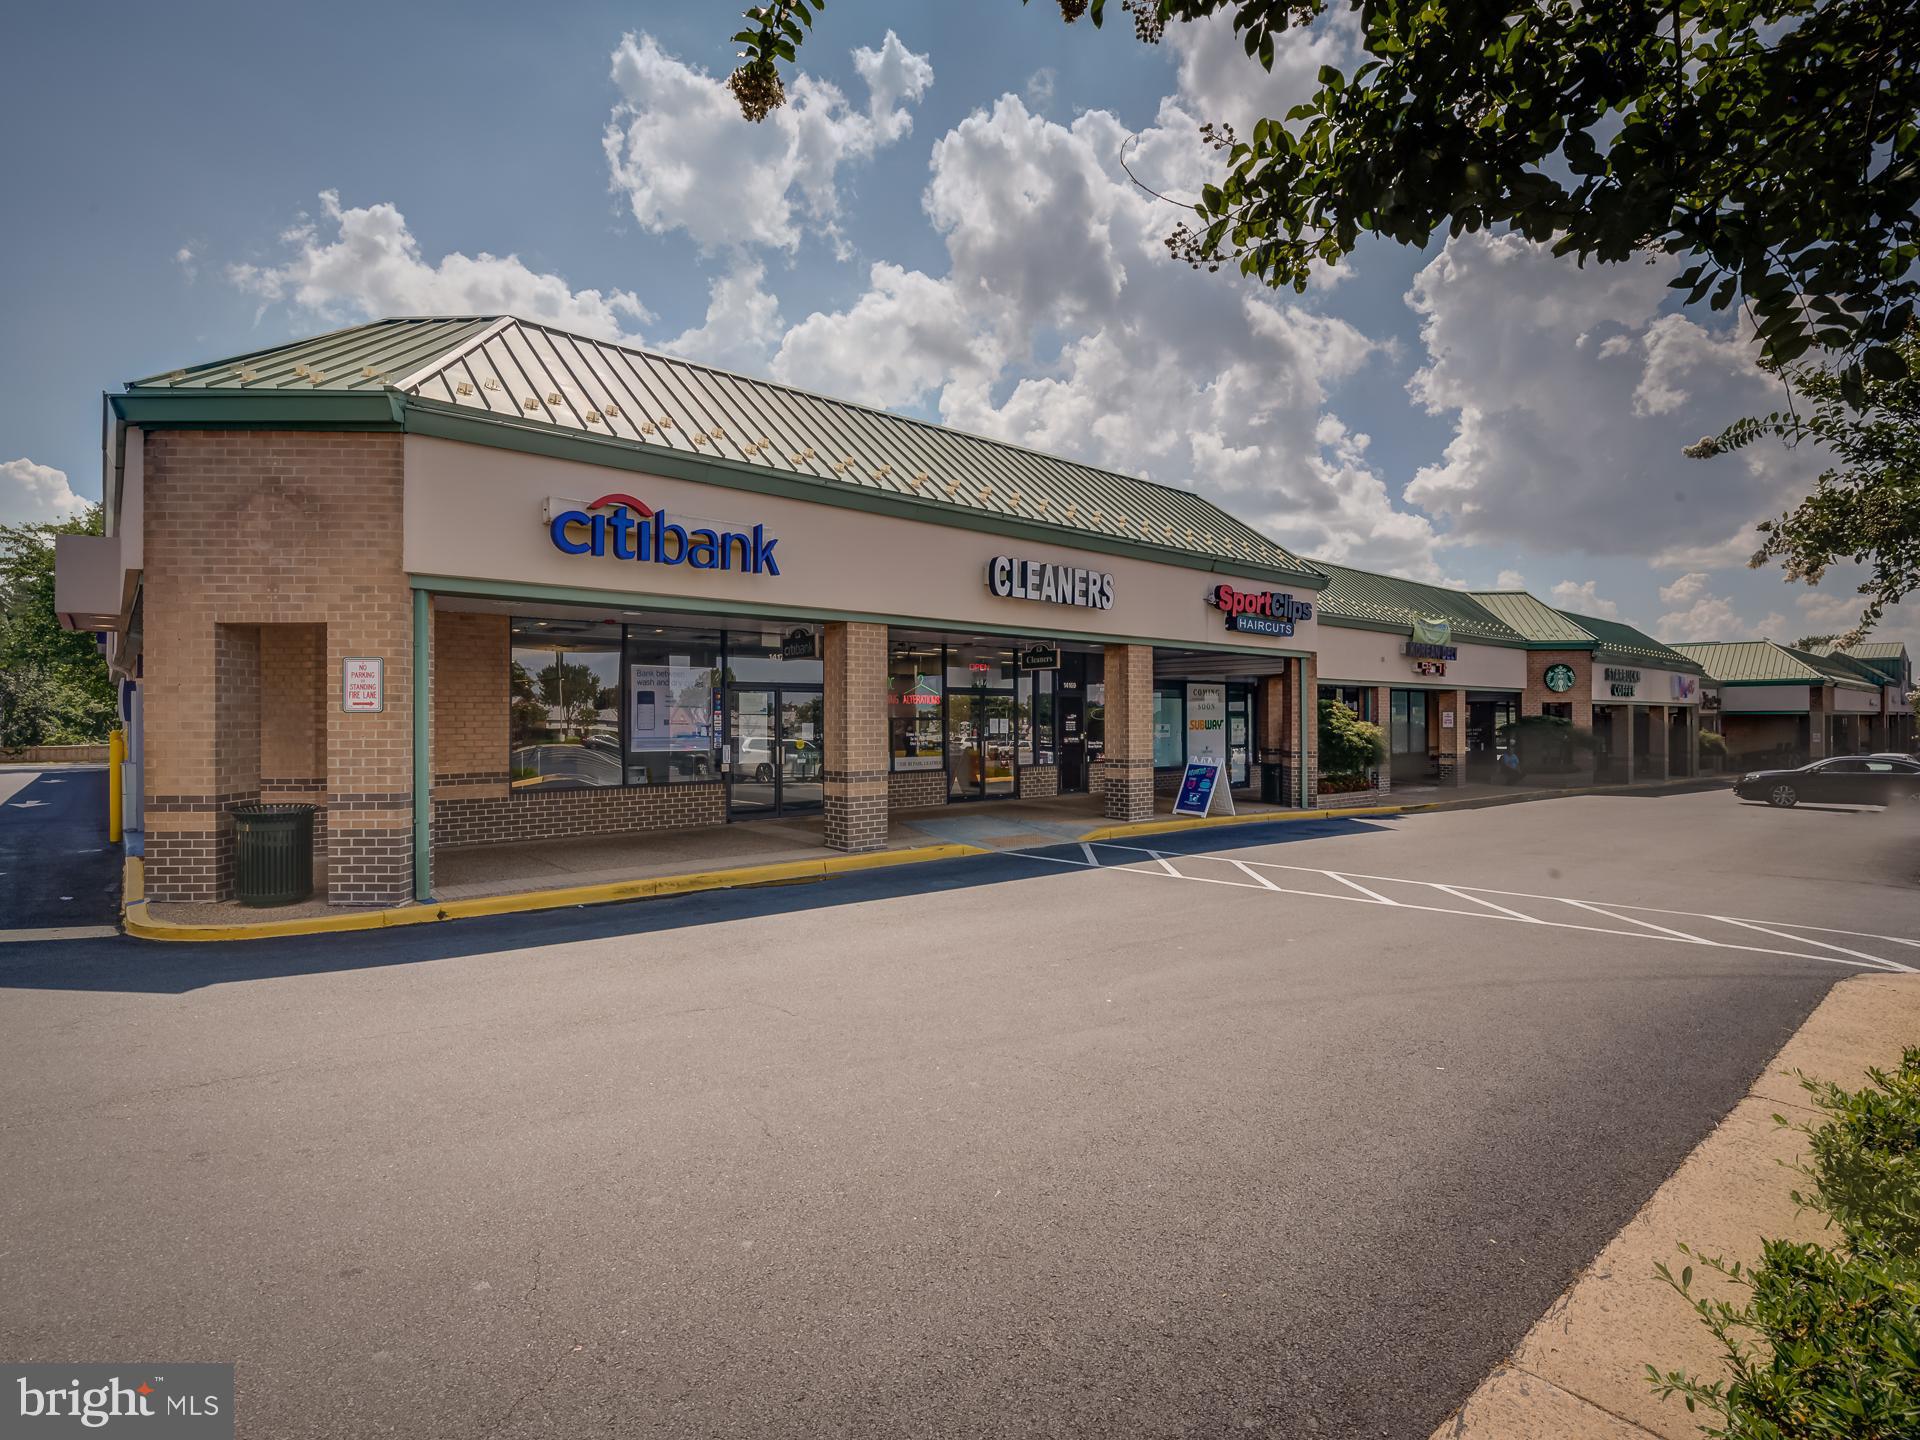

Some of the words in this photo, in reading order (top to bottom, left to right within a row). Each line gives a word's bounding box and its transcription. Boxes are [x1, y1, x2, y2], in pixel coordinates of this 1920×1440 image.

[550, 494, 780, 576] citibank
[989, 555, 1115, 610] CLEANERS
[1239, 618, 1292, 634] HAIRCUTS
[1026, 656, 1053, 664] Cleaners
[968, 663, 992, 672] OPEN
[349, 691, 360, 699] FIRE
[363, 691, 377, 699] LANE
[1193, 689, 1220, 697] COMING
[903, 694, 941, 704] ALTERATIONS
[1189, 720, 1224, 730] SUBWAY
